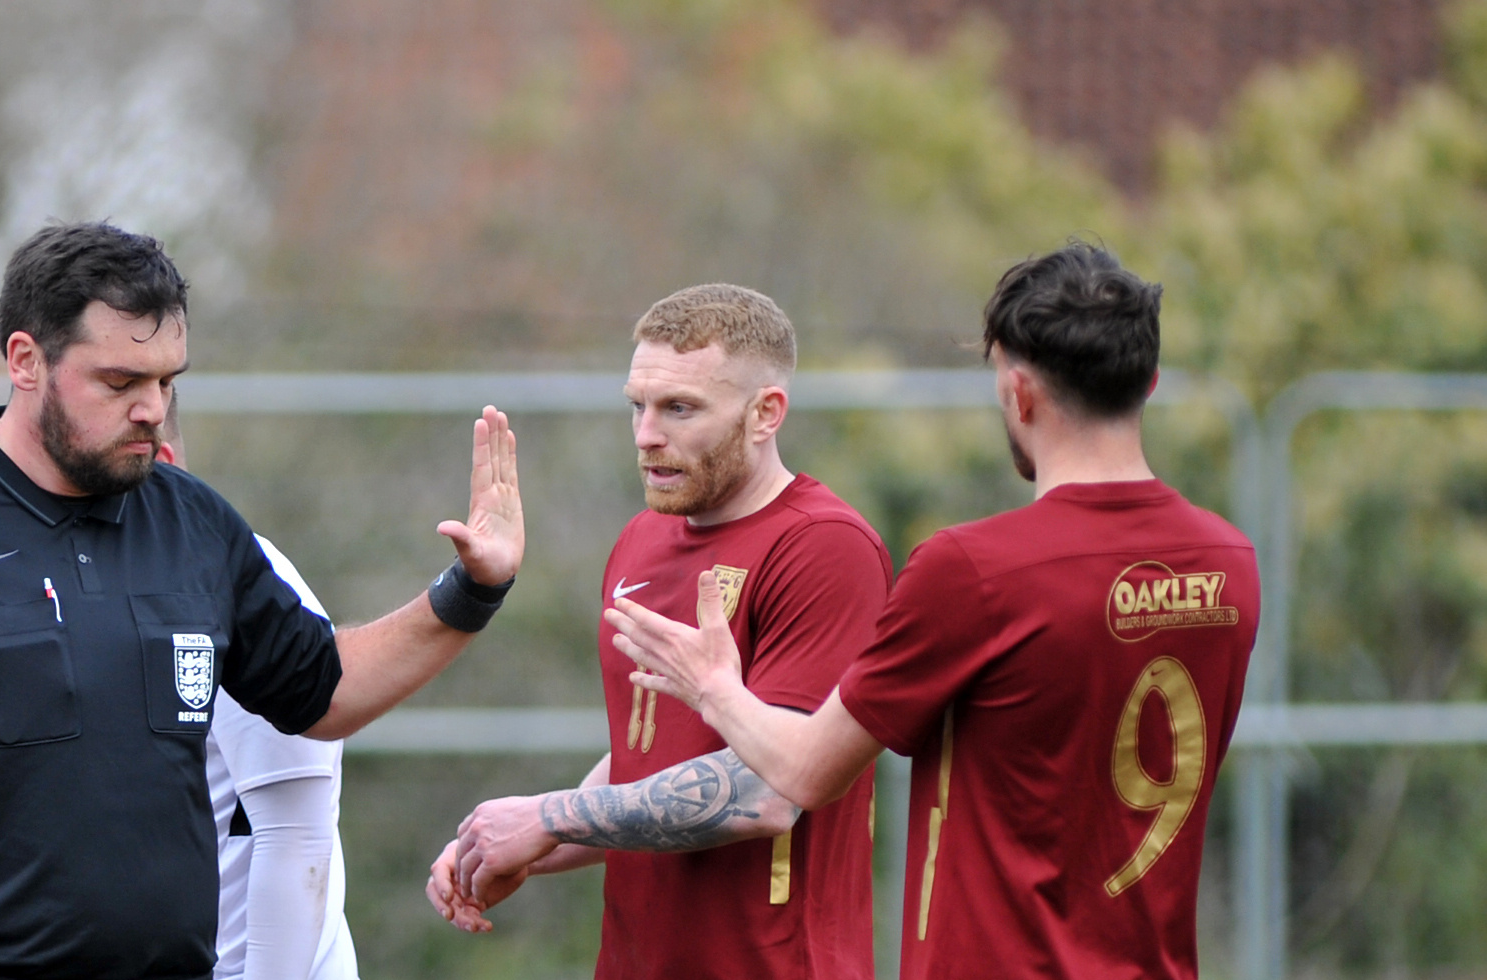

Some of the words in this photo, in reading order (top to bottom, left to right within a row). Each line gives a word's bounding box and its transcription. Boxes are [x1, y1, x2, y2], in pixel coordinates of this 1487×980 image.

[1115, 575, 1220, 614] OAKLEY
[1116, 615, 1141, 630] BUILDERS
[1104, 655, 1207, 897] 9
